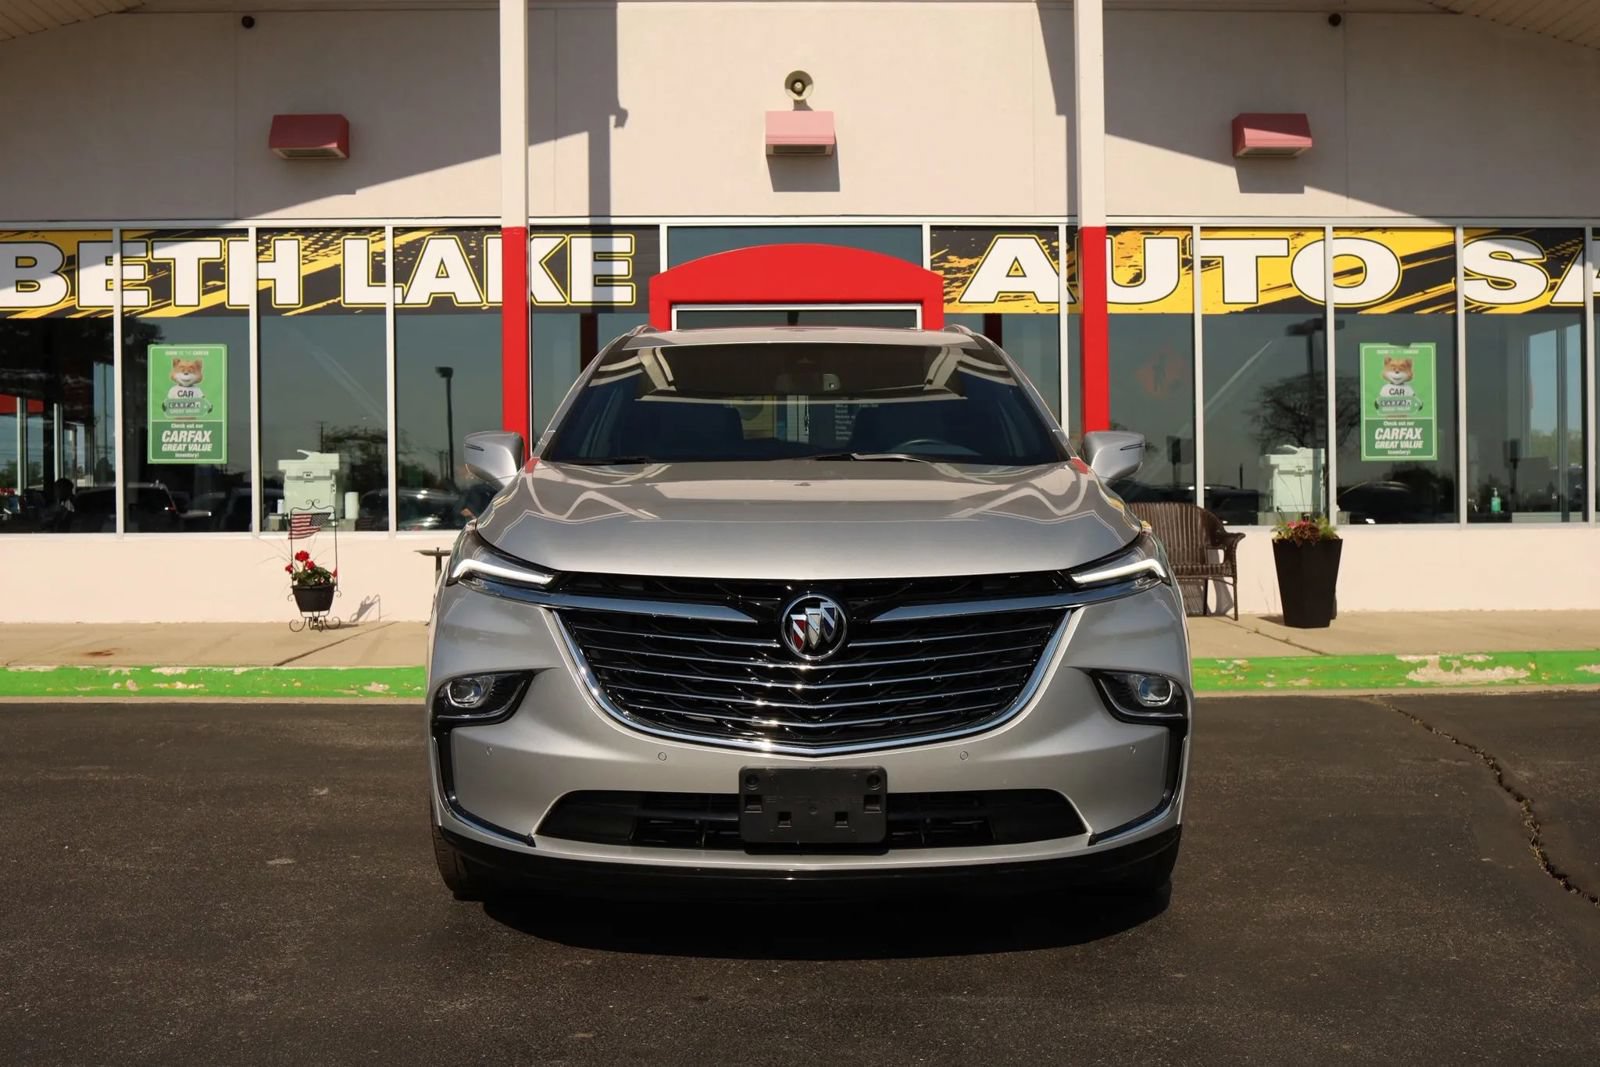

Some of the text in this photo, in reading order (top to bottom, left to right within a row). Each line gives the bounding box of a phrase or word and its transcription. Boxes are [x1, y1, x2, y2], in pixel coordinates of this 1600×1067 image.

[0, 237, 303, 309] BETH
[341, 234, 636, 307] LAKE
[957, 234, 1402, 308] AUTO
[177, 390, 194, 398] CAR
[1388, 388, 1405, 396] CAR
[162, 430, 213, 443] CARFAX
[1375, 427, 1423, 440] CARFAX
[162, 443, 213, 452] GREAT VALUE
[1375, 440, 1424, 449] GREAT VALUE
